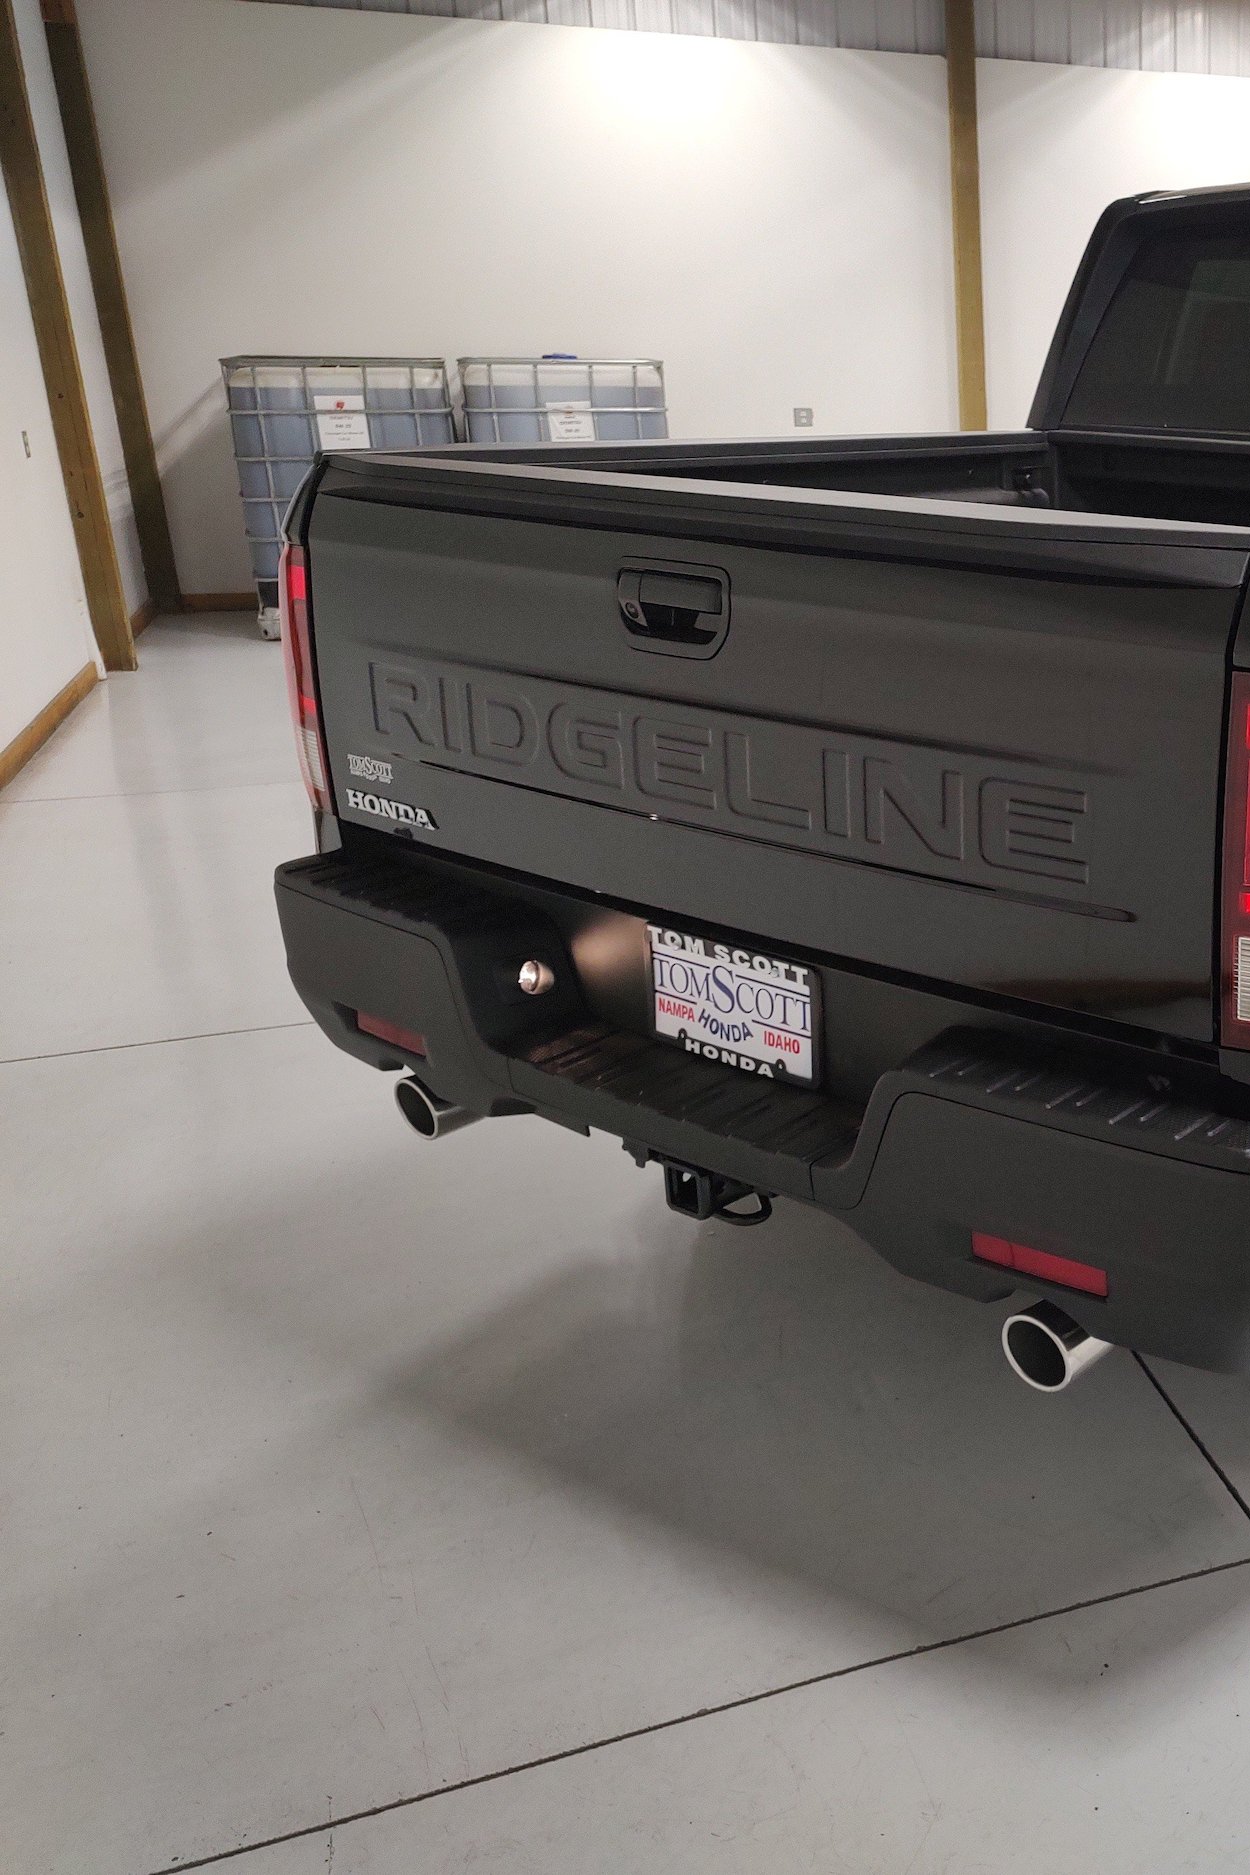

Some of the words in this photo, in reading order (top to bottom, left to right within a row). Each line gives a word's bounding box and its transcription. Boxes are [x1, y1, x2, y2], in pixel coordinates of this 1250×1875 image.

[367, 661, 1089, 885] RIDGELINE
[346, 789, 435, 831] HONDA
[647, 925, 705, 958] TOM
[714, 944, 808, 986] SCOTT
[658, 997, 696, 1022] NAMPA
[698, 1009, 754, 1043] HONDA
[685, 1039, 774, 1078] HONDA
[763, 1031, 800, 1054] IDAHO
